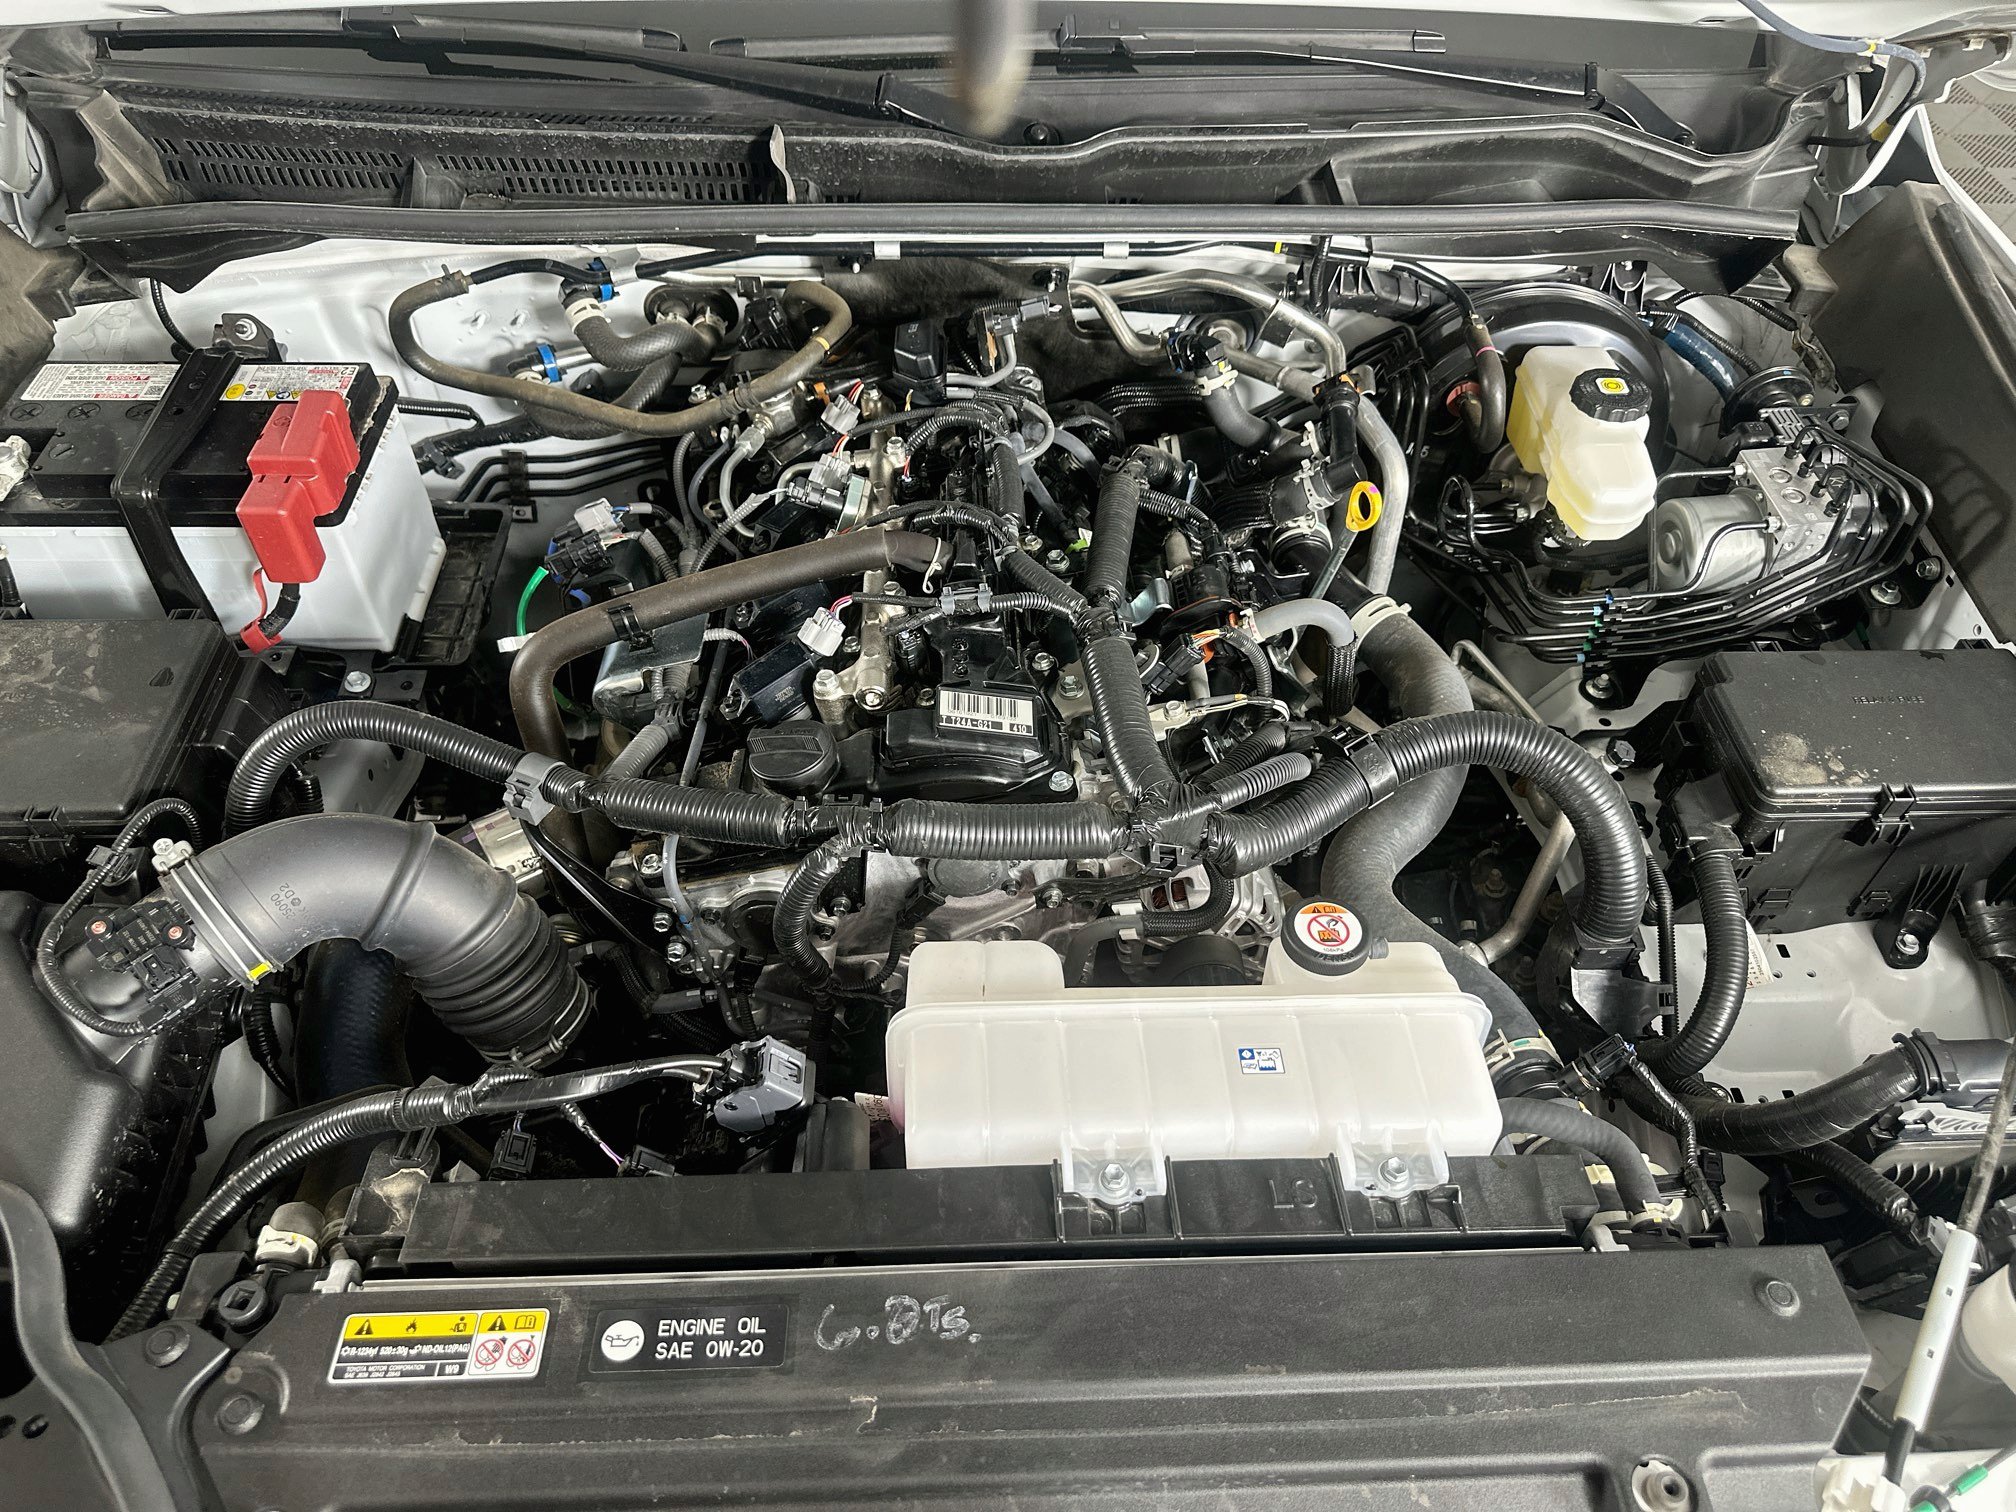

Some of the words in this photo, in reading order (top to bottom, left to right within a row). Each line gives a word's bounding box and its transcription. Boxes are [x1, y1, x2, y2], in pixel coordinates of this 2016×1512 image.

[341, 366, 356, 376] E2
[951, 717, 992, 729] T24A-G21
[1012, 724, 1027, 734] 410
[1268, 1177, 1318, 1209] LS
[657, 1317, 726, 1336] ENGINE
[737, 1316, 767, 1334] OIL
[655, 1341, 694, 1359] SAE
[705, 1339, 764, 1358] 0W-20
[445, 1364, 460, 1374] W9
